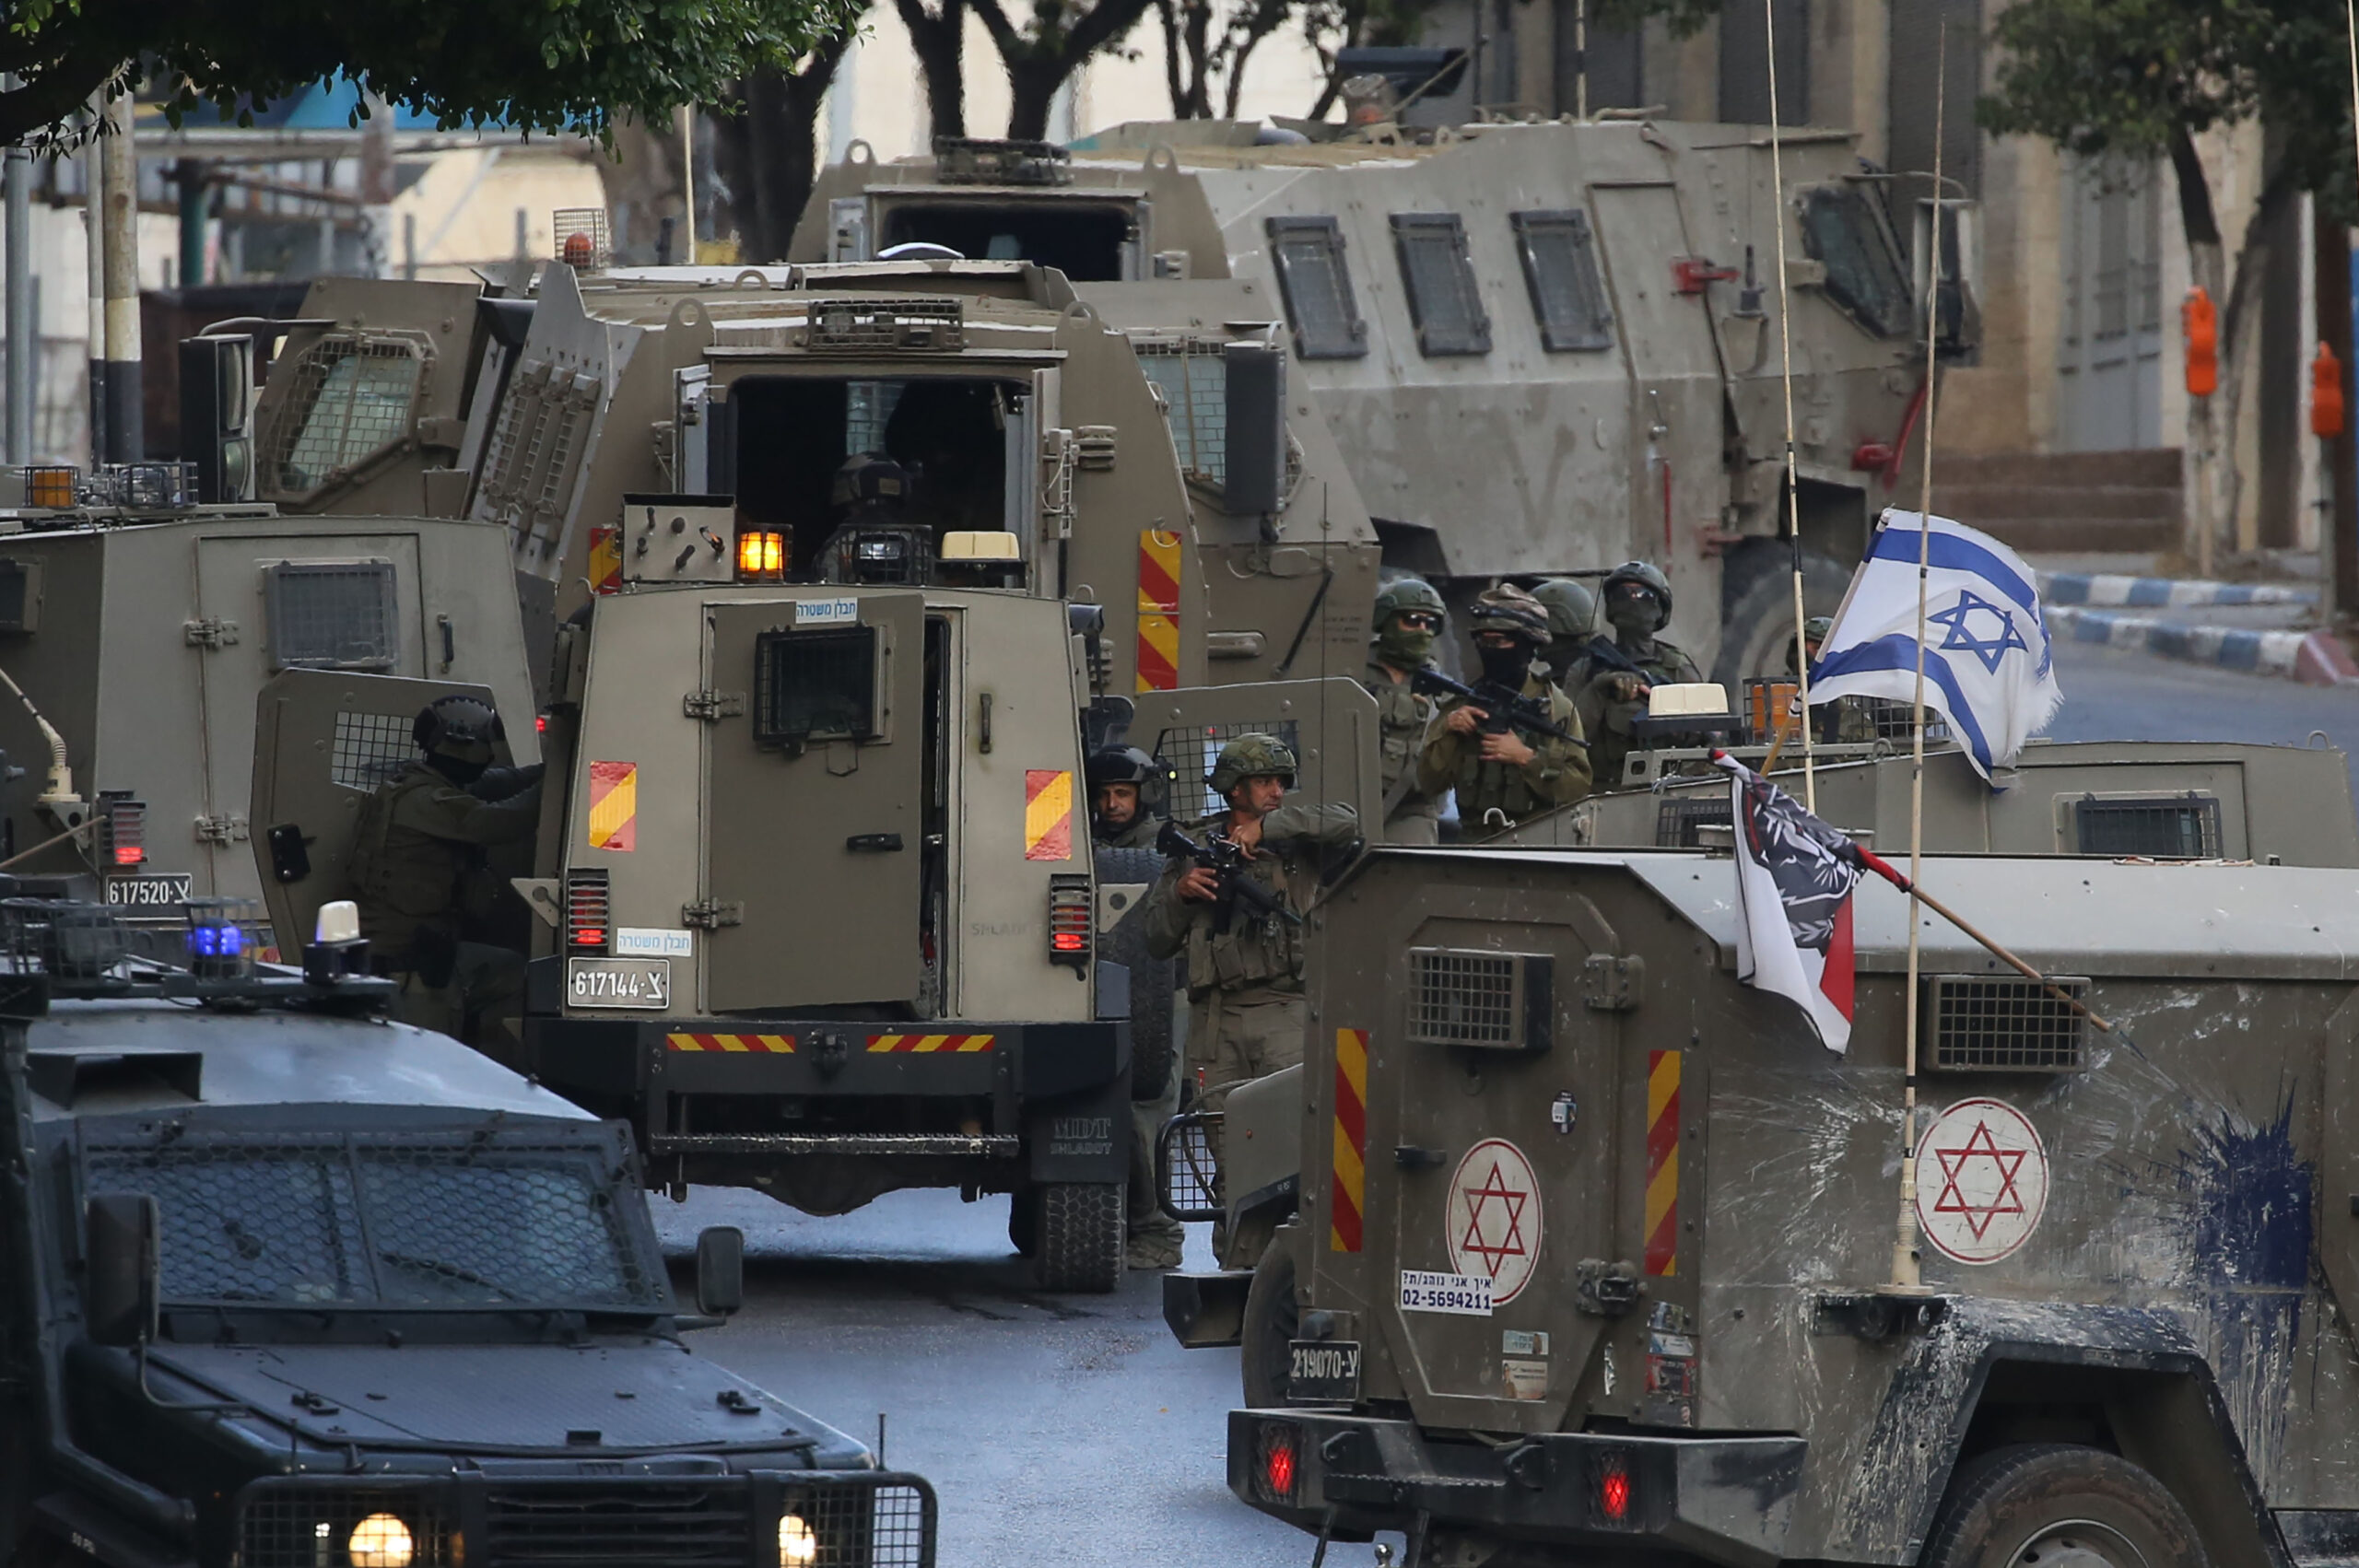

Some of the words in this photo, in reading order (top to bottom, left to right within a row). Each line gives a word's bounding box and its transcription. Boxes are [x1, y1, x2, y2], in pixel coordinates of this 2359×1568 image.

[796, 603, 831, 616] משטרה
[618, 935, 661, 948] משטרה
[1053, 1117, 1111, 1140] MDT
[1451, 1276, 1468, 1287] אני
[1474, 1278, 1491, 1291] איך
[1402, 1289, 1491, 1310] 02-5694211
